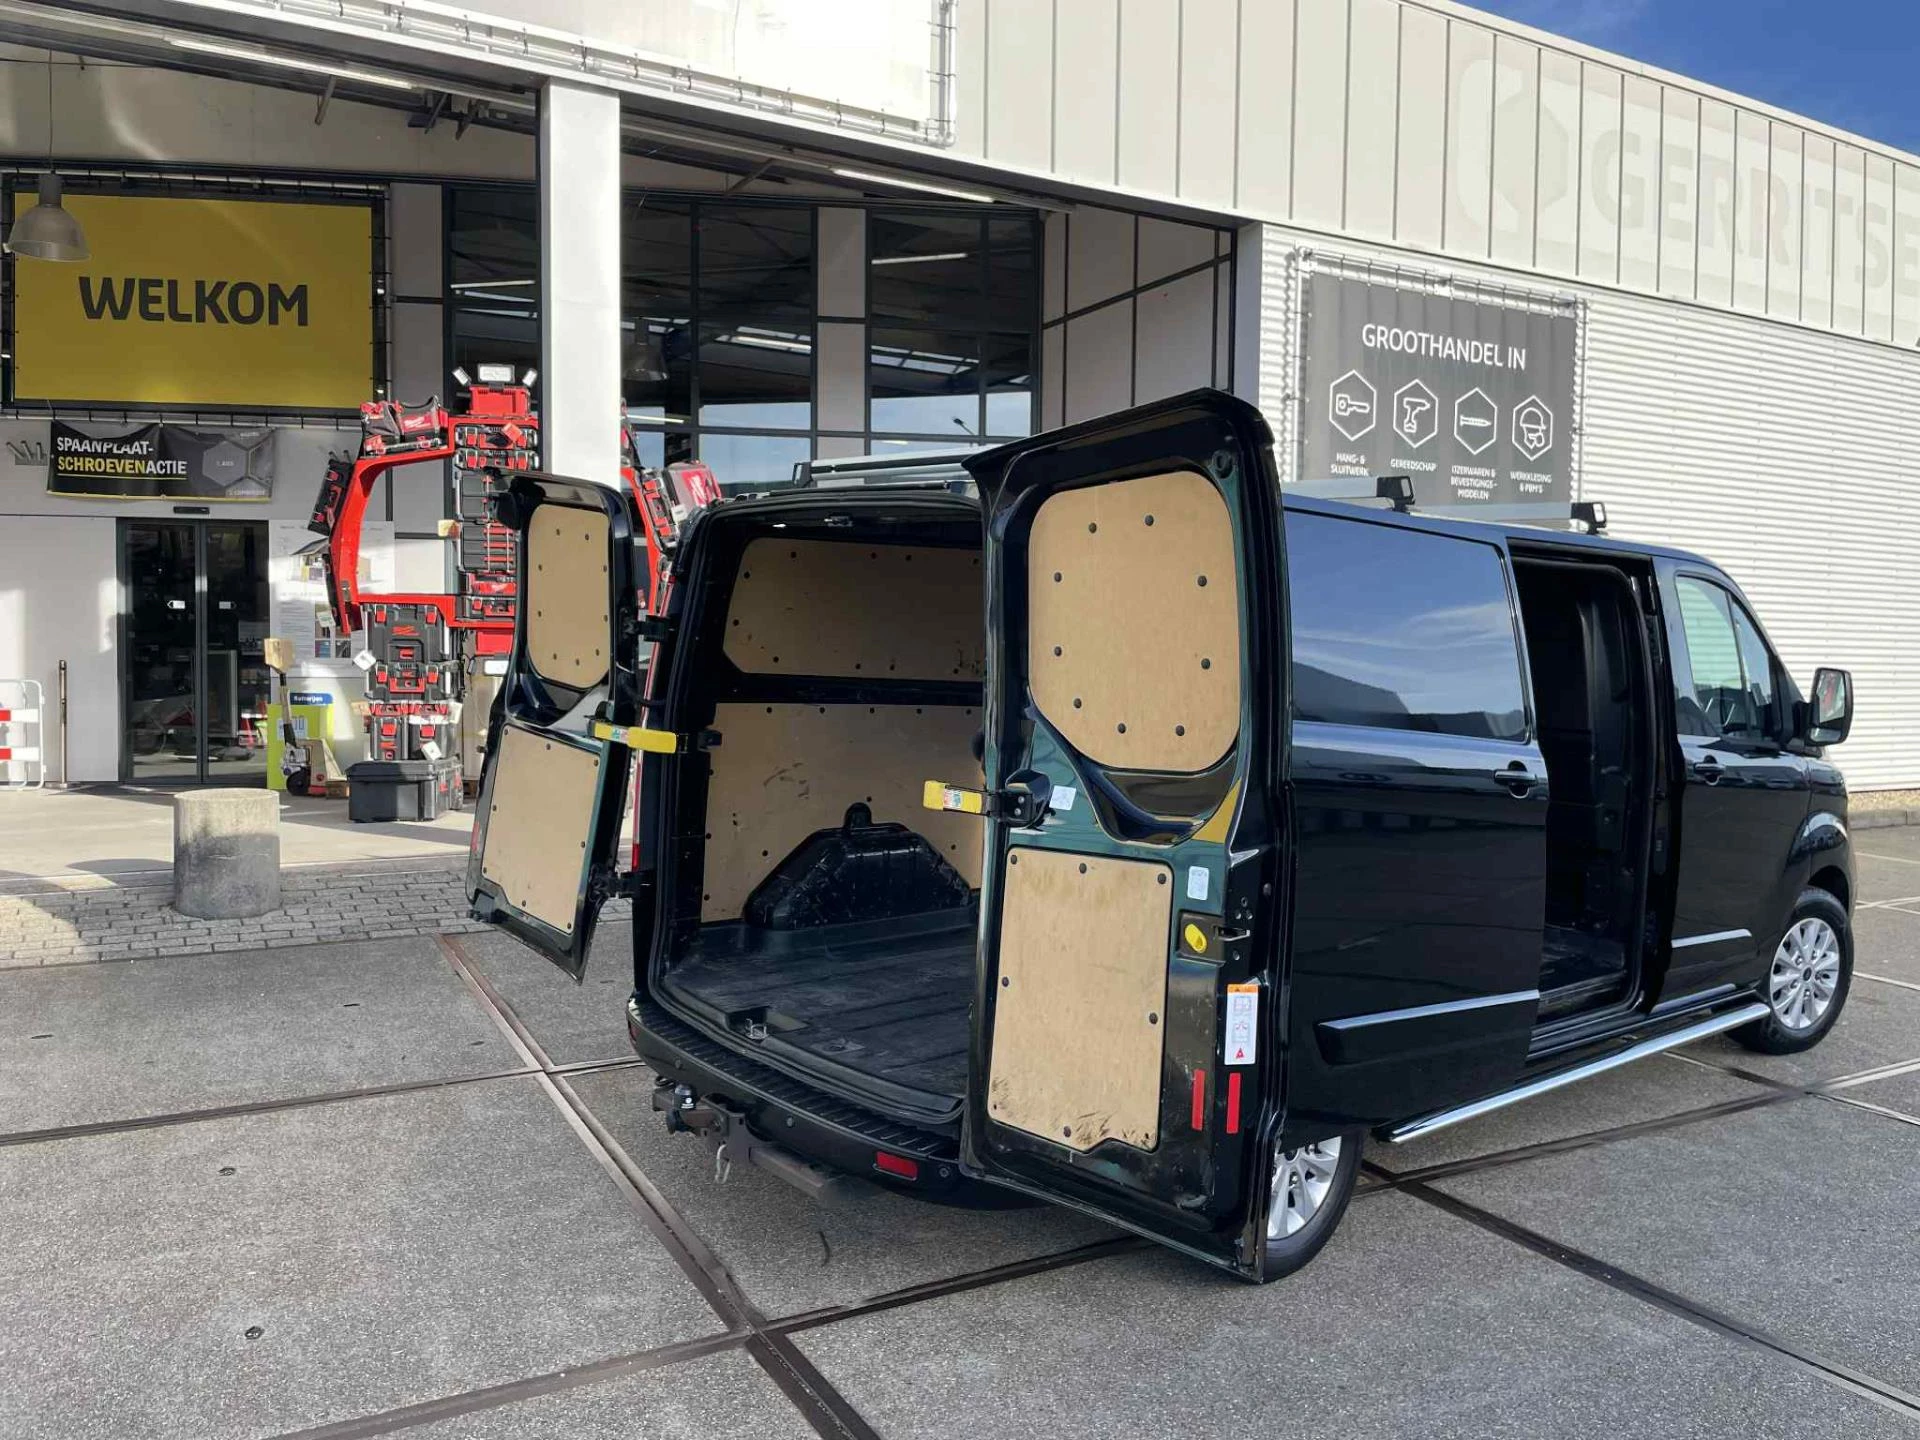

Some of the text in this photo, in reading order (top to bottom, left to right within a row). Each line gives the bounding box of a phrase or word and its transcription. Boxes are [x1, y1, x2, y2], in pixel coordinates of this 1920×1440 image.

[78, 276, 309, 327] WELKOM
[1362, 323, 1526, 371] GROOTHANDEL IN
[1336, 452, 1359, 464] HANG-
[57, 456, 187, 475] SCHROEVENACTIE
[1330, 464, 1370, 477] SLUITWERK
[1390, 458, 1438, 472] GEREEDSCHAP
[1510, 471, 1553, 484] WERKKLEDING
[1457, 488, 1489, 500] MIDDELEN
